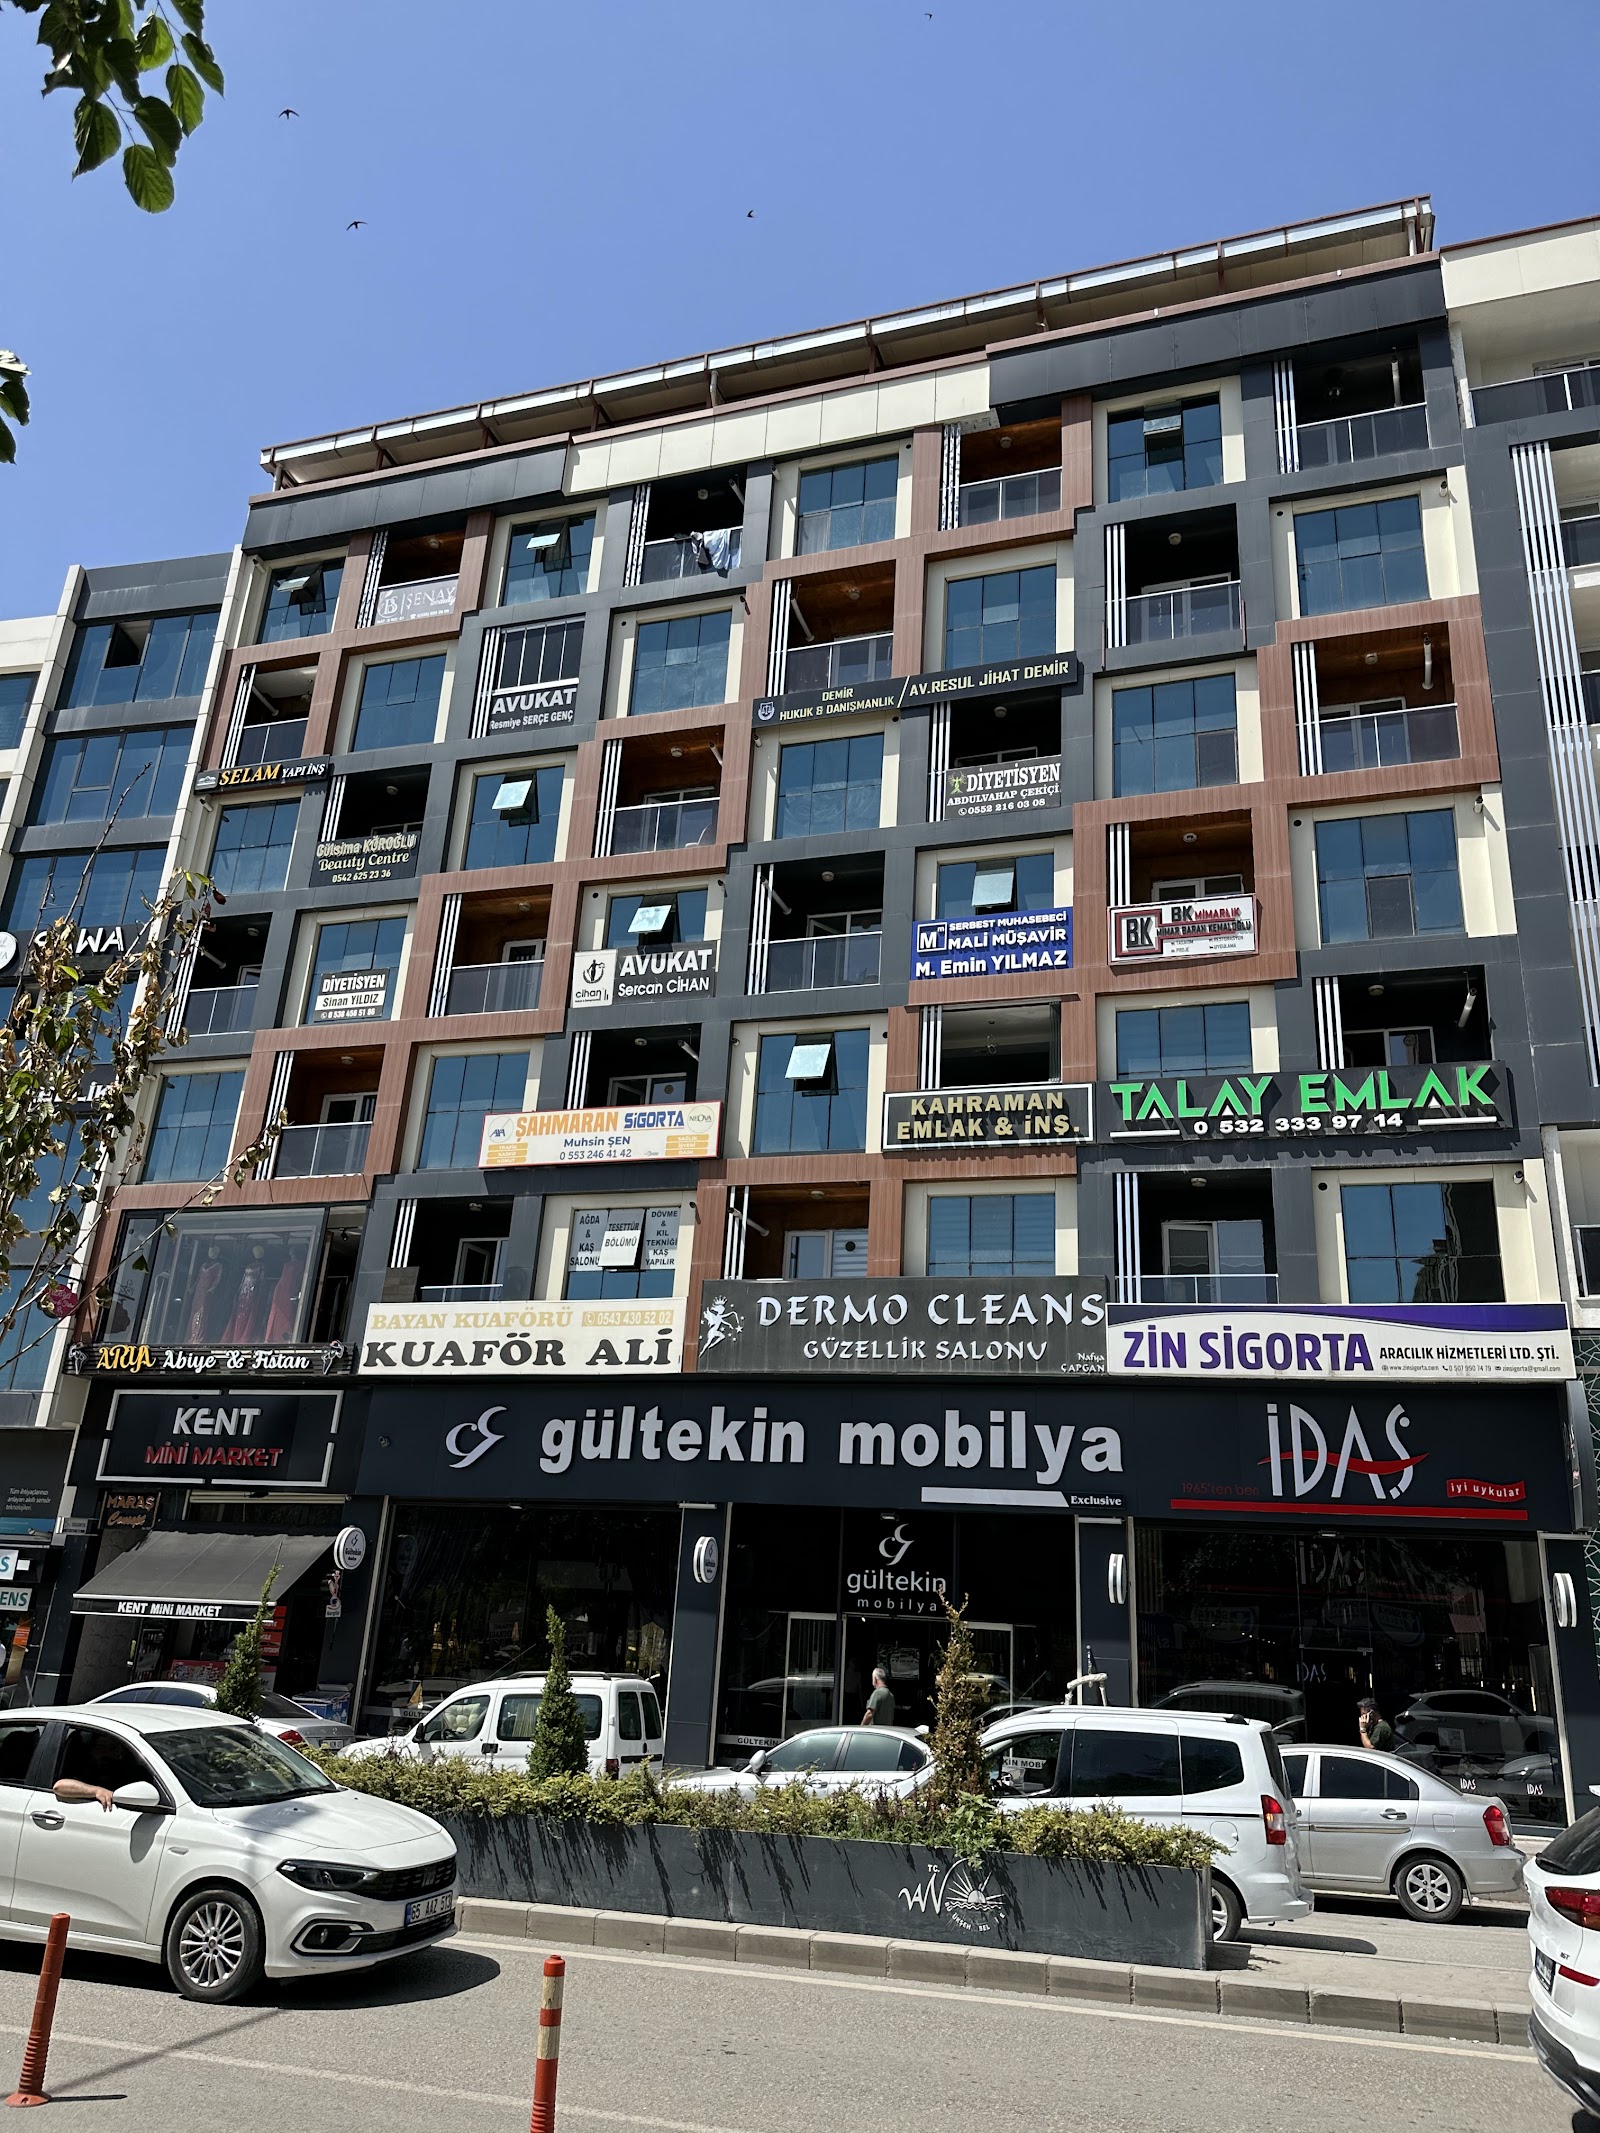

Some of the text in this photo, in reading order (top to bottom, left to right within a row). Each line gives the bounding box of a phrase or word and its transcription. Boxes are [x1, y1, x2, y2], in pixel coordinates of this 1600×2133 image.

[407, 587, 456, 609] ŞENAY
[909, 660, 1068, 696] AV.RESUL JİHAT DEMİR
[492, 688, 577, 714] AVUKAT
[822, 687, 853, 702] DEMİR
[780, 696, 894, 720] HUKUK & DANIŞMANLIK
[490, 710, 573, 730] Resmiye SERÇE GENÇ
[219, 763, 325, 785] SELAM YAPI İNŞ
[966, 763, 1061, 792] DİYETİSYEN
[947, 783, 1059, 806] ABDULVAHAP ÇEKİÇİ
[968, 798, 1045, 815] 0552 216 03 08
[318, 853, 410, 871] Beauty Centre
[333, 874, 351, 883] 0542
[353, 872, 367, 880] 625
[369, 870, 379, 878] 23
[950, 911, 1066, 931] SERBEST MUHASEBECİ
[1171, 906, 1240, 922] BK MİMARLIK
[949, 926, 1066, 950] MALİ MÜŞAVİR
[1126, 917, 1153, 948] BK
[620, 949, 712, 976] AVUKAT
[916, 950, 1066, 977] M. Emin YILMAZ
[322, 973, 385, 992] DİYETİSYEN
[618, 976, 710, 996] Sercan CİHAN
[323, 994, 379, 1007] Sinan YILDIZ
[576, 989, 601, 1000] cihan
[911, 1092, 1063, 1116] KAHRAMAN
[1109, 1065, 1494, 1121] TALAY EMLAK
[490, 1129, 506, 1138] AXA
[516, 1111, 618, 1142] ŞAHMARAN
[897, 1117, 1013, 1140] EMLAK &
[1194, 1113, 1403, 1135] 0 532 333 97 14
[564, 1136, 631, 1147] Muhsin ŞEN
[560, 1152, 565, 1160] 0
[587, 1150, 604, 1159] 246
[606, 1150, 617, 1158] 41
[620, 1149, 632, 1157] 42
[580, 1214, 600, 1224] AĞDA
[586, 1229, 591, 1238] &
[605, 1237, 637, 1247] BÖLÜMÜ
[647, 1237, 677, 1246] TEKNİĞİ
[579, 1243, 594, 1253] KAŞ
[570, 1257, 600, 1266] SALONU
[371, 1306, 671, 1329] BAYAN KUAFÖRÜ 0543 430 52 02
[756, 1293, 1105, 1326] DERMO CLEANS
[96, 1344, 310, 1373] ARYA Abiye & Fistan
[362, 1328, 673, 1367] KUAFÖR ALİ
[803, 1336, 1048, 1361] GÜZELLİK SALONU
[1124, 1325, 1559, 1371] ZİN SİGORTA ARACILIK HİZMETLERİ LTD. ŞTİ.
[1061, 1364, 1104, 1372] ÇAPGAN
[173, 1407, 262, 1436] KENT
[144, 1441, 284, 1466] MİNİ MARKET
[539, 1405, 1123, 1485] gültekin mobilya
[1451, 1482, 1519, 1497] iyi uykular
[1070, 1495, 1121, 1507] Exclusive
[847, 1569, 946, 1593] gültekin
[118, 1602, 148, 1613] KENT
[176, 1604, 222, 1617] MARKET
[857, 1598, 936, 1613] mobilya
